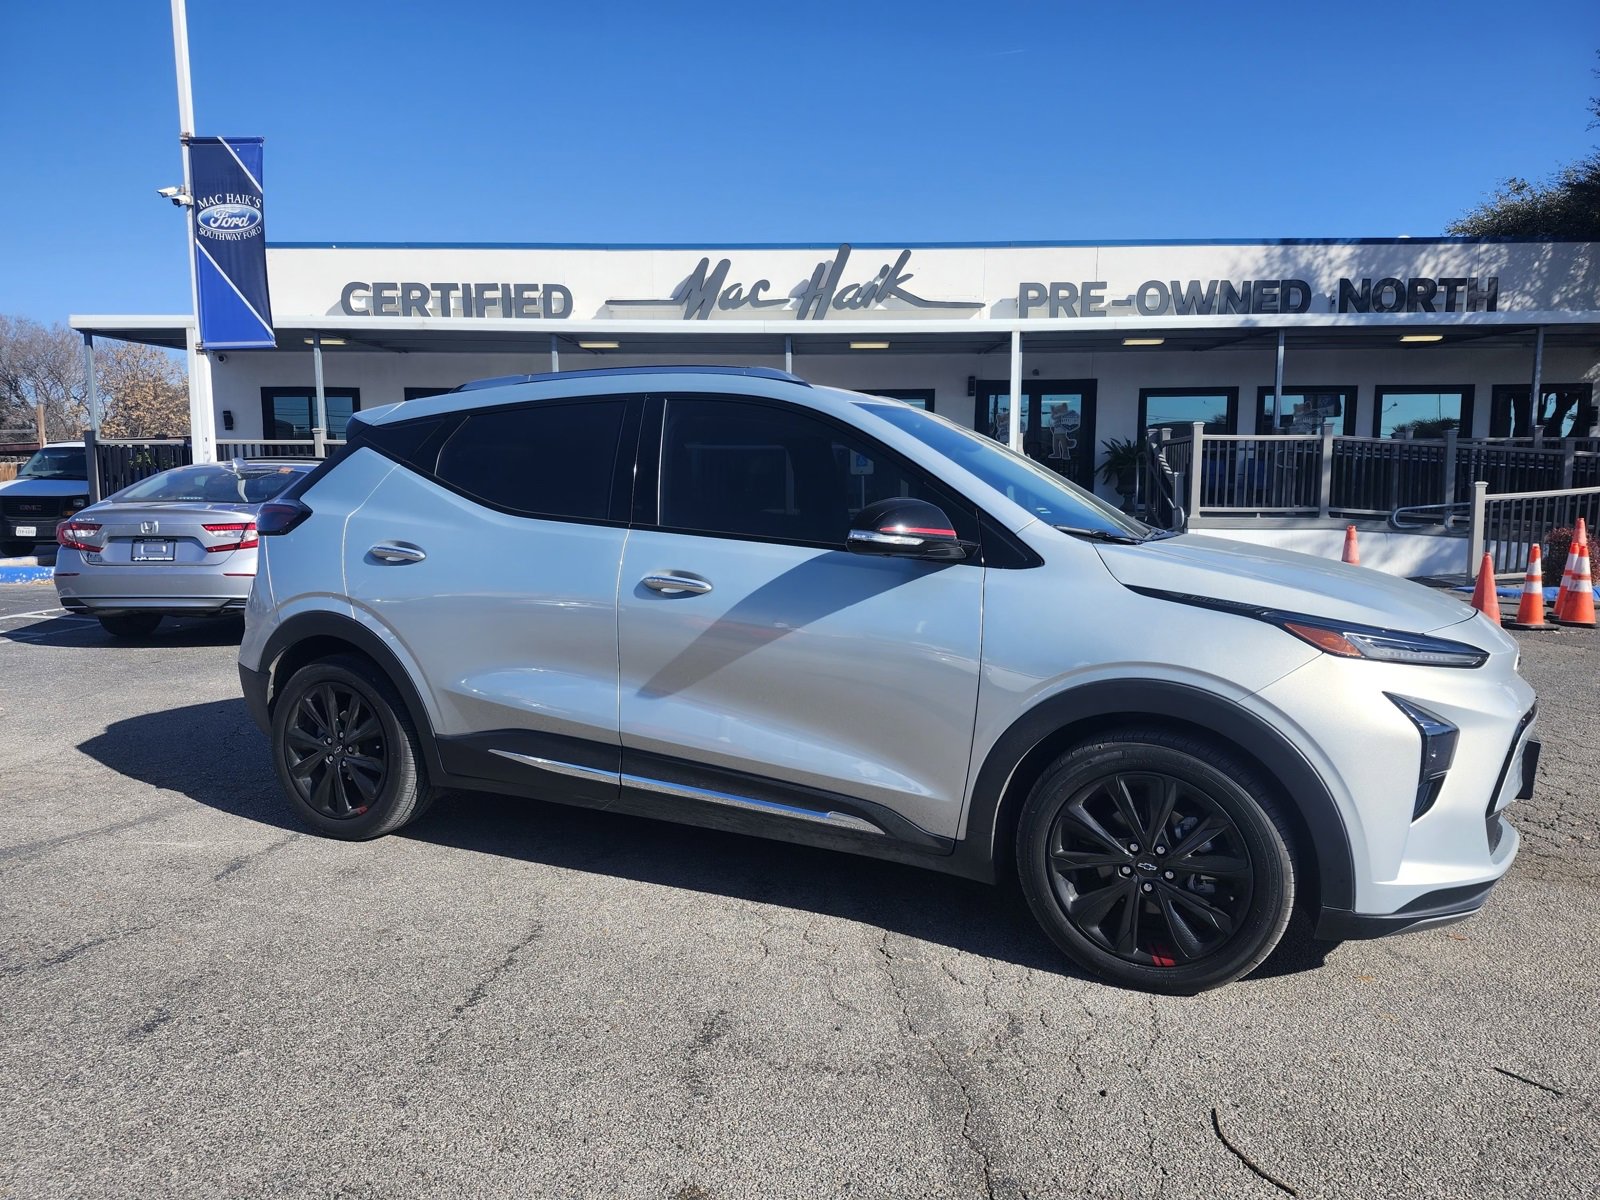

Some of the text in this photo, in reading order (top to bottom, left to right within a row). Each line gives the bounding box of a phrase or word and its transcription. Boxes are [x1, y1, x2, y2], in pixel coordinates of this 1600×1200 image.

[197, 193, 262, 210] MAC HAIK'S
[209, 208, 250, 228] Ford
[198, 225, 262, 241] SOUTHWAY FORD
[604, 243, 986, 320] Mac Haik
[340, 281, 574, 319] CERTIFIED
[1018, 276, 1499, 319] PRE-OWNED NORTH
